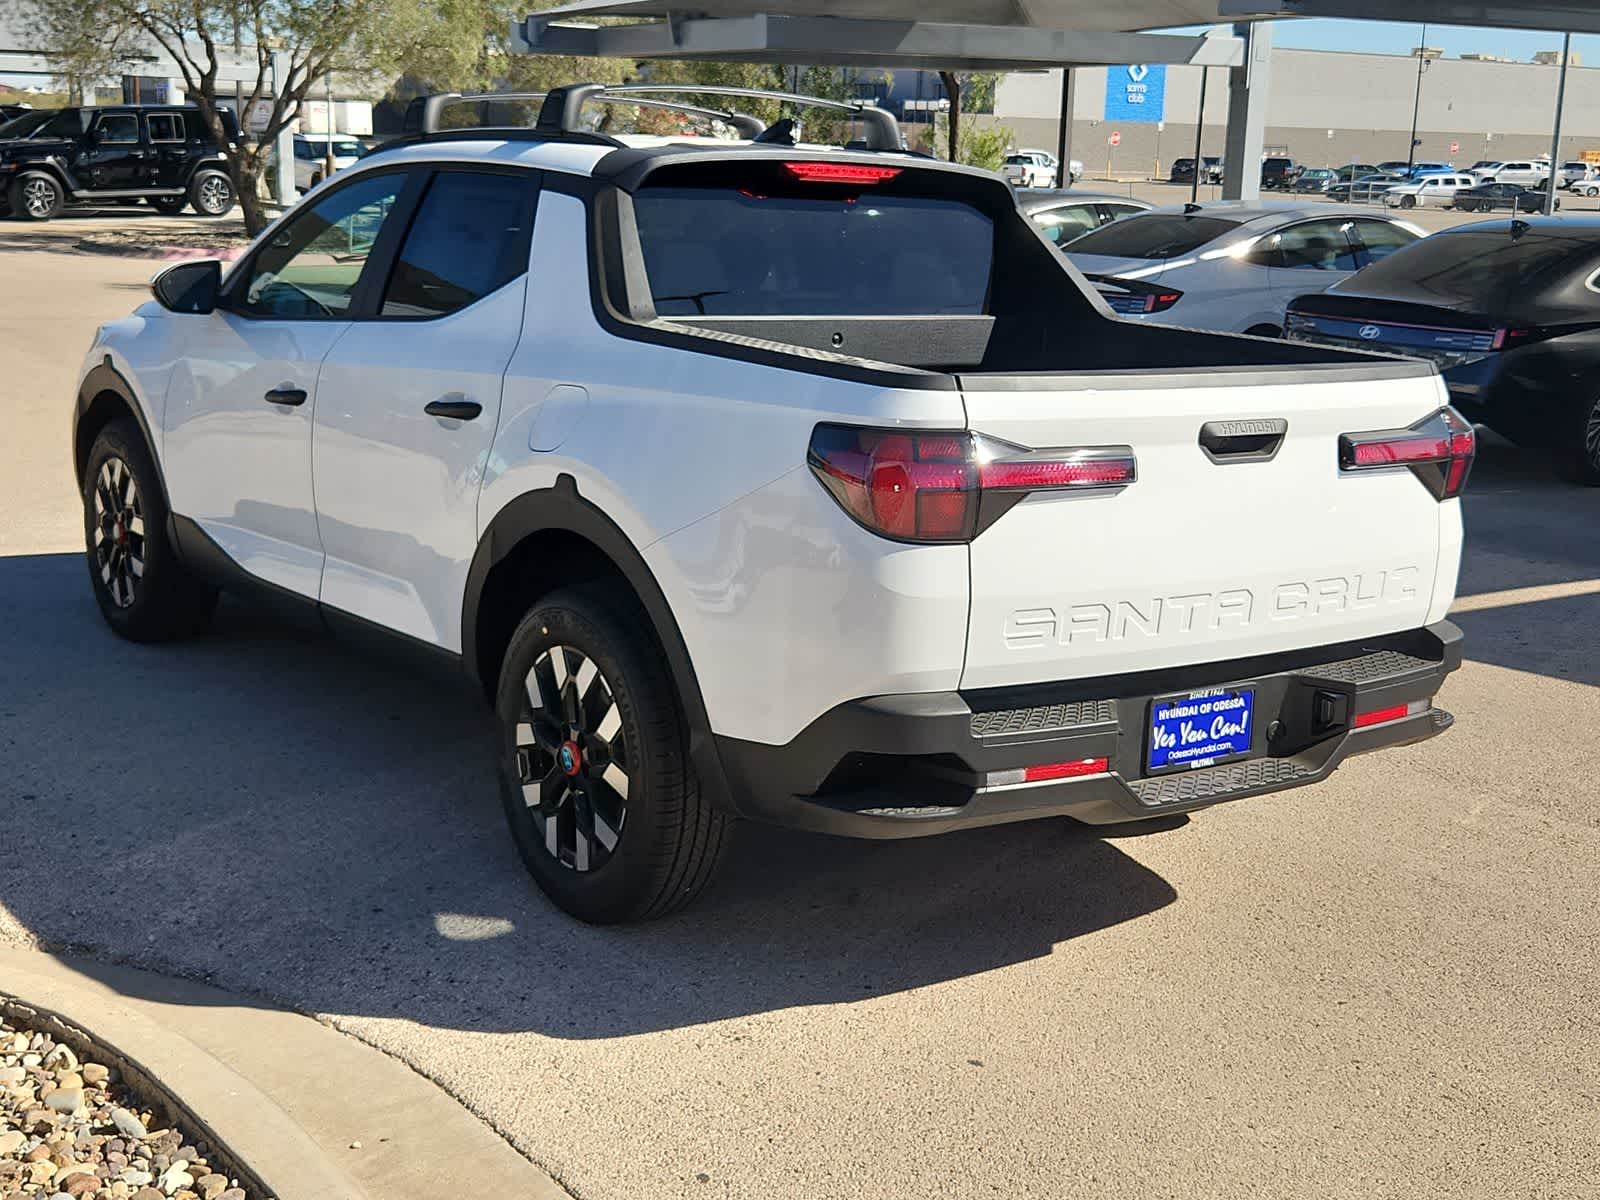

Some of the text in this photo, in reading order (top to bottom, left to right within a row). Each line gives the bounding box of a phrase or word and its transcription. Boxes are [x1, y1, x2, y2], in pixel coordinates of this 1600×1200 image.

[1221, 420, 1277, 435] HYUNDAI
[1004, 588, 1254, 648] SANTA
[1159, 698, 1245, 720] HYUNDAI OF ODESSA
[1153, 710, 1248, 750] Yes You Can!
